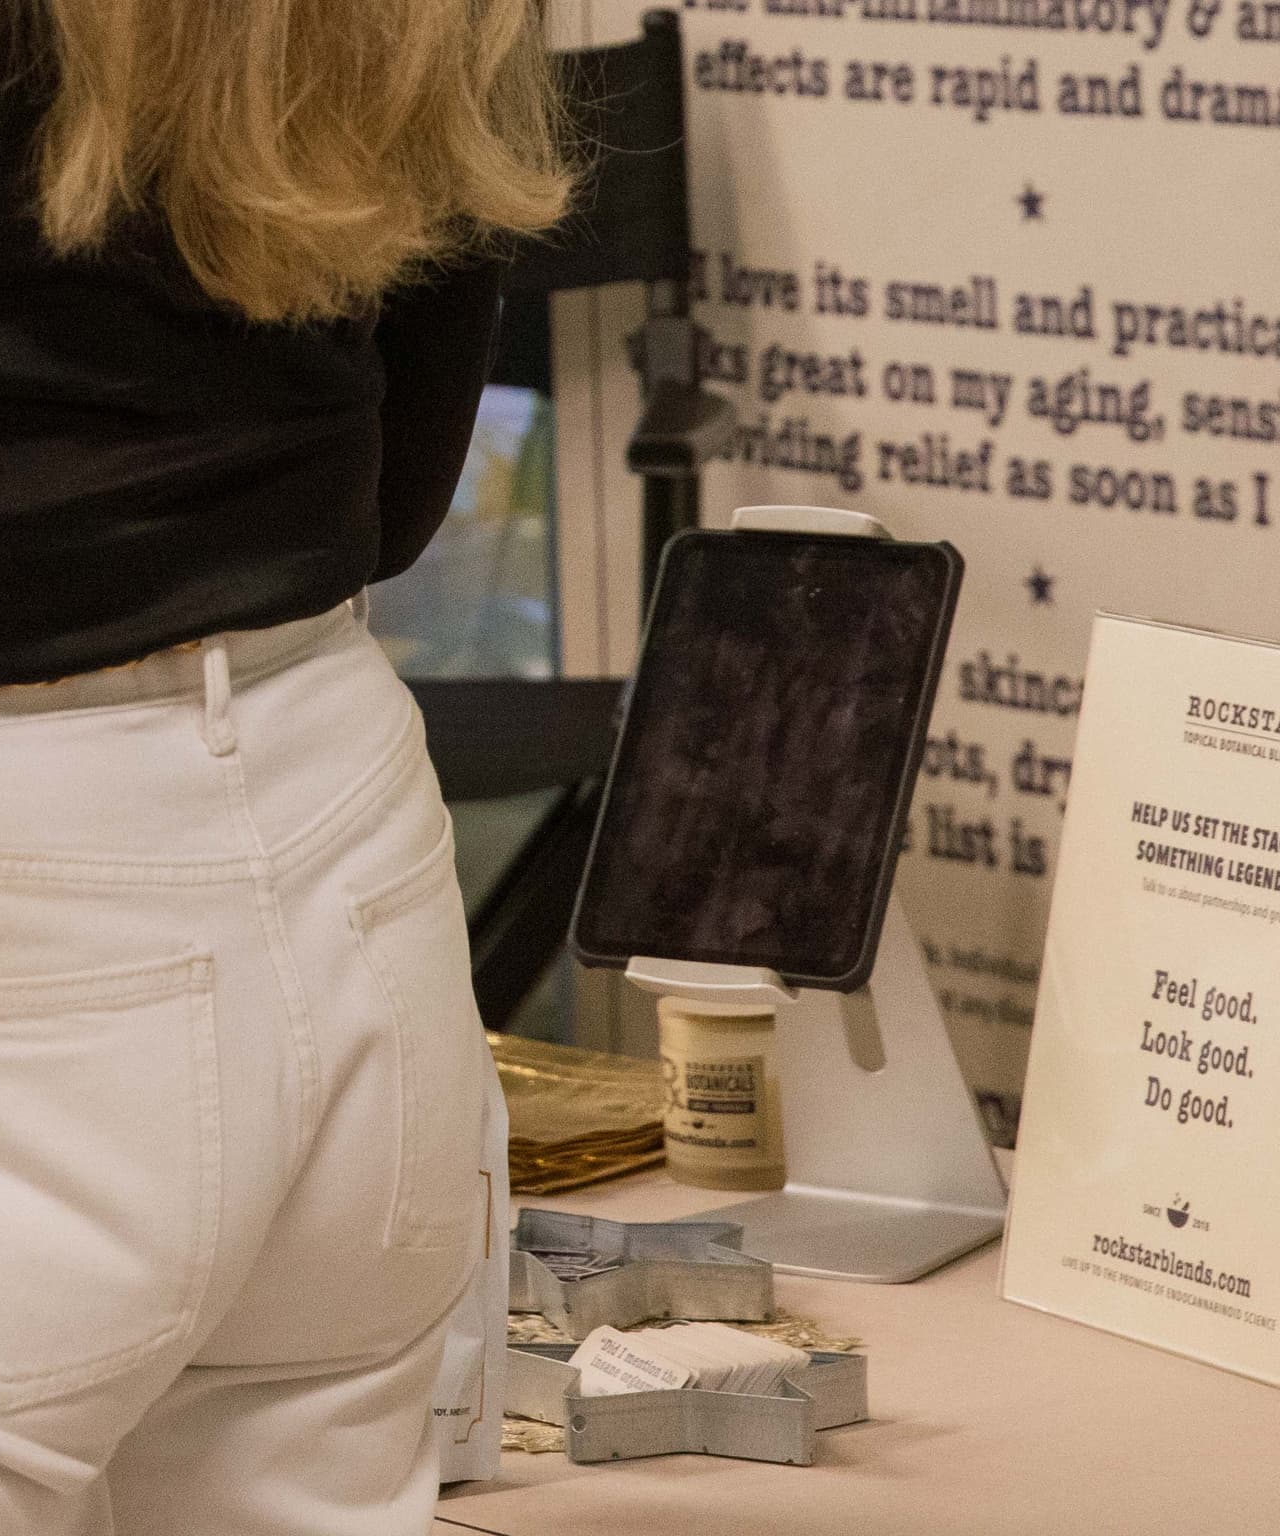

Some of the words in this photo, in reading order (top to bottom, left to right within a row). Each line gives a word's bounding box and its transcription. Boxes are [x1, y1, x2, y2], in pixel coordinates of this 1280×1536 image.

[694, 39, 829, 98] effects
[845, 60, 915, 103] are
[932, 54, 1040, 123] rapid
[1058, 65, 1142, 118] and
[1161, 65, 1280, 125] dram
[721, 250, 801, 312] love
[815, 260, 870, 318] its
[885, 275, 998, 331] smell
[1014, 284, 1095, 341] and
[760, 342, 868, 403] great
[883, 360, 937, 405] on
[950, 364, 1015, 429] my
[1027, 368, 1168, 443] aging,
[878, 438, 994, 494] relief
[1007, 460, 1052, 503] as
[1070, 463, 1178, 515] soon
[1194, 482, 1238, 523] as
[1252, 472, 1273, 526] I
[1184, 730, 1219, 750] TOPICAL
[1219, 737, 1267, 760] BOTANICAL
[1131, 800, 1169, 829] HELP
[1171, 810, 1192, 834] US
[1193, 815, 1220, 840] SET
[1221, 820, 1250, 847] THE
[1136, 839, 1225, 880] SOMETHING
[1151, 969, 1199, 1010] Feel
[1202, 983, 1259, 1025] good.
[1140, 1020, 1192, 1063] Look
[1197, 1039, 1255, 1079] good.
[1145, 1075, 1173, 1112] Do
[1176, 1086, 1235, 1129] good.
[1092, 1233, 1252, 1298] rockstarblends.com
